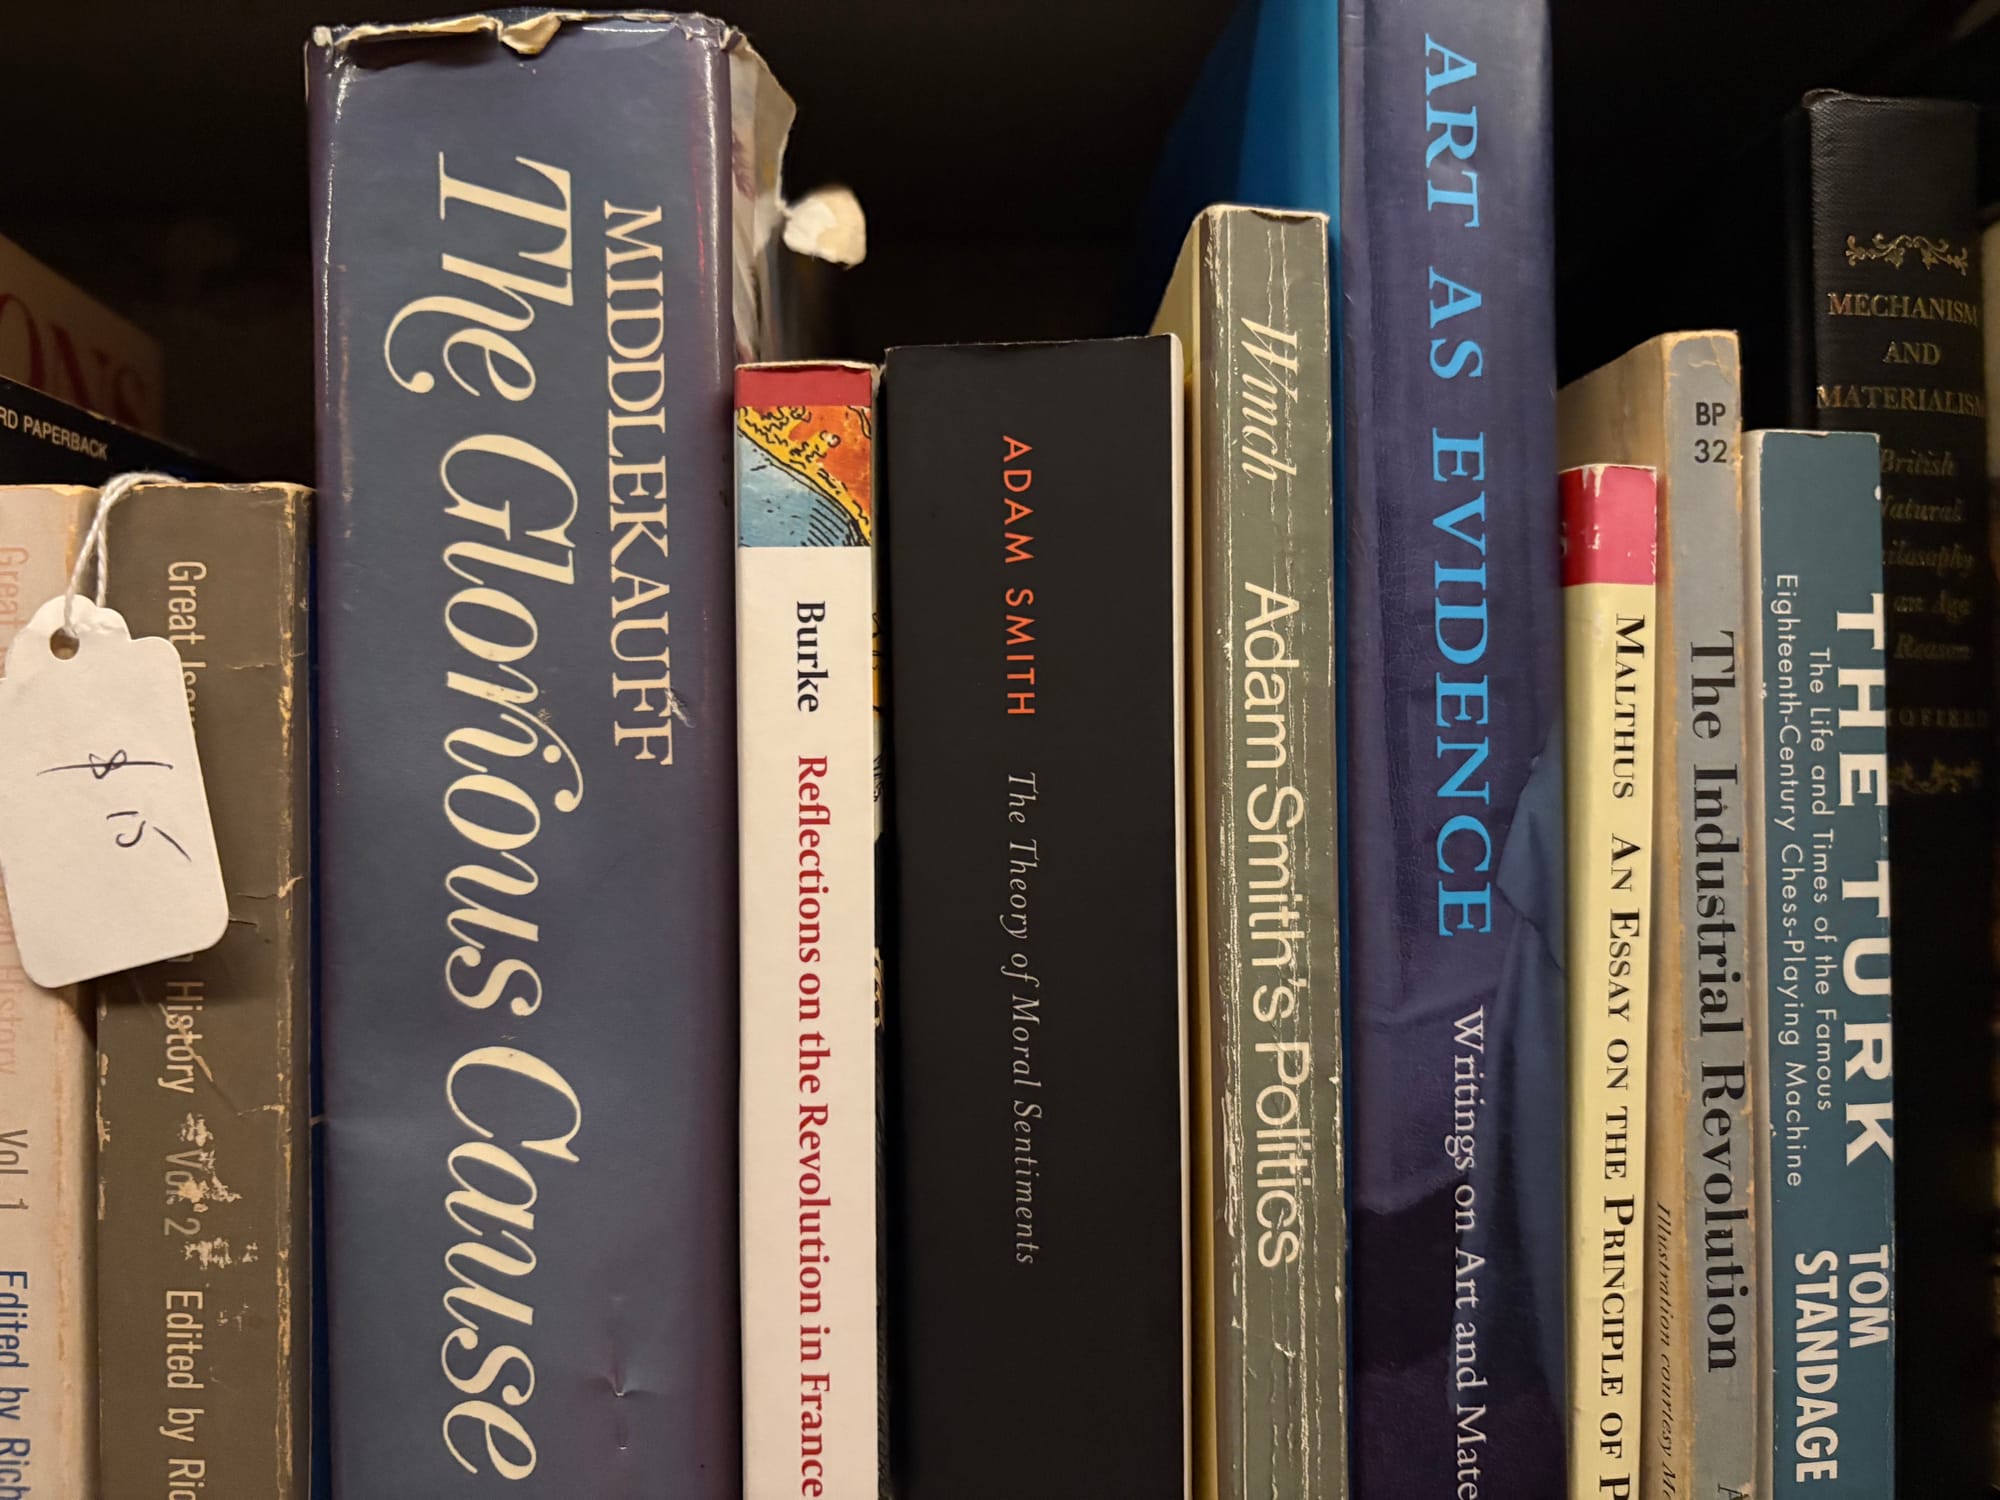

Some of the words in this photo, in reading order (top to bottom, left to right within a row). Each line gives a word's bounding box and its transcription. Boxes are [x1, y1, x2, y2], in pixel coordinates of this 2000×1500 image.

[1425, 33, 1480, 228] ART
[384, 151, 574, 401] The
[1428, 266, 1483, 379] AS
[1827, 292, 1979, 328] MECHANISM
[1241, 317, 1299, 482] Winch
[1816, 384, 1987, 418] MATERIALISM
[1882, 341, 1942, 366] AND
[23, 415, 108, 461] PAPERBACK
[1694, 402, 1727, 426] BP
[1694, 438, 1728, 463] 32
[603, 200, 673, 767] MIDDLEKAUFF
[1002, 435, 1034, 564] ADAM
[168, 560, 206, 645] Great
[796, 600, 829, 713] Burke
[1005, 587, 1036, 715] SMITH
[440, 434, 584, 1016] Glorious
[1244, 581, 1301, 769] Adam
[1432, 427, 1492, 936] EVIDENCE
[1612, 613, 1646, 799] MALTHUS
[1690, 629, 1737, 740] The
[1771, 573, 1804, 831] Eighteenth-Century
[1808, 648, 1831, 694] The
[1836, 592, 1889, 806] THE
[1809, 707, 1834, 752] Life
[1007, 771, 1037, 825] The
[1811, 765, 1836, 816] and
[798, 755, 831, 962] Reflections
[1000, 838, 1038, 941] Theory
[1247, 784, 1307, 1023] Smith's
[1610, 833, 1641, 892] AN
[1693, 764, 1744, 1037] Industrial
[1812, 829, 1834, 903] Times
[1000, 952, 1040, 988] of
[1608, 908, 1640, 1022] ESSAY
[1776, 844, 1807, 1046] Chess-Playing
[1814, 916, 1837, 943] of
[1814, 955, 1838, 996] the
[158, 981, 205, 1094] History
[798, 972, 821, 1021] on
[1011, 994, 1042, 1087] Moral
[1842, 860, 1895, 1166] TURK
[798, 1031, 831, 1093] the
[1445, 1005, 1486, 1171] Writings
[1606, 1038, 1629, 1091] ON
[1815, 1008, 1837, 1111] Famous
[1254, 1042, 1311, 1268] Politics
[1604, 1106, 1628, 1180] THE
[1784, 1062, 1810, 1187] Machine
[164, 1217, 201, 1236] 2
[798, 1103, 831, 1315] Revolution
[1014, 1100, 1042, 1265] Sentiments
[1455, 1185, 1476, 1232] on
[1701, 1060, 1748, 1372] Revolution
[440, 1046, 582, 1480] Cause
[1455, 1246, 1487, 1308] Art
[1601, 1194, 1635, 1396] PRINCIPLE
[1656, 1201, 1676, 1348] Illustration
[1848, 1244, 1890, 1349] TOM
[166, 1289, 205, 1389] Edited
[799, 1324, 831, 1362] in
[1456, 1321, 1488, 1392] and
[1794, 1250, 1839, 1484] STANDAGE
[159, 1407, 205, 1443] by
[800, 1372, 831, 1498] France
[1600, 1412, 1623, 1459] OF
[1658, 1353, 1677, 1457] courtesy
